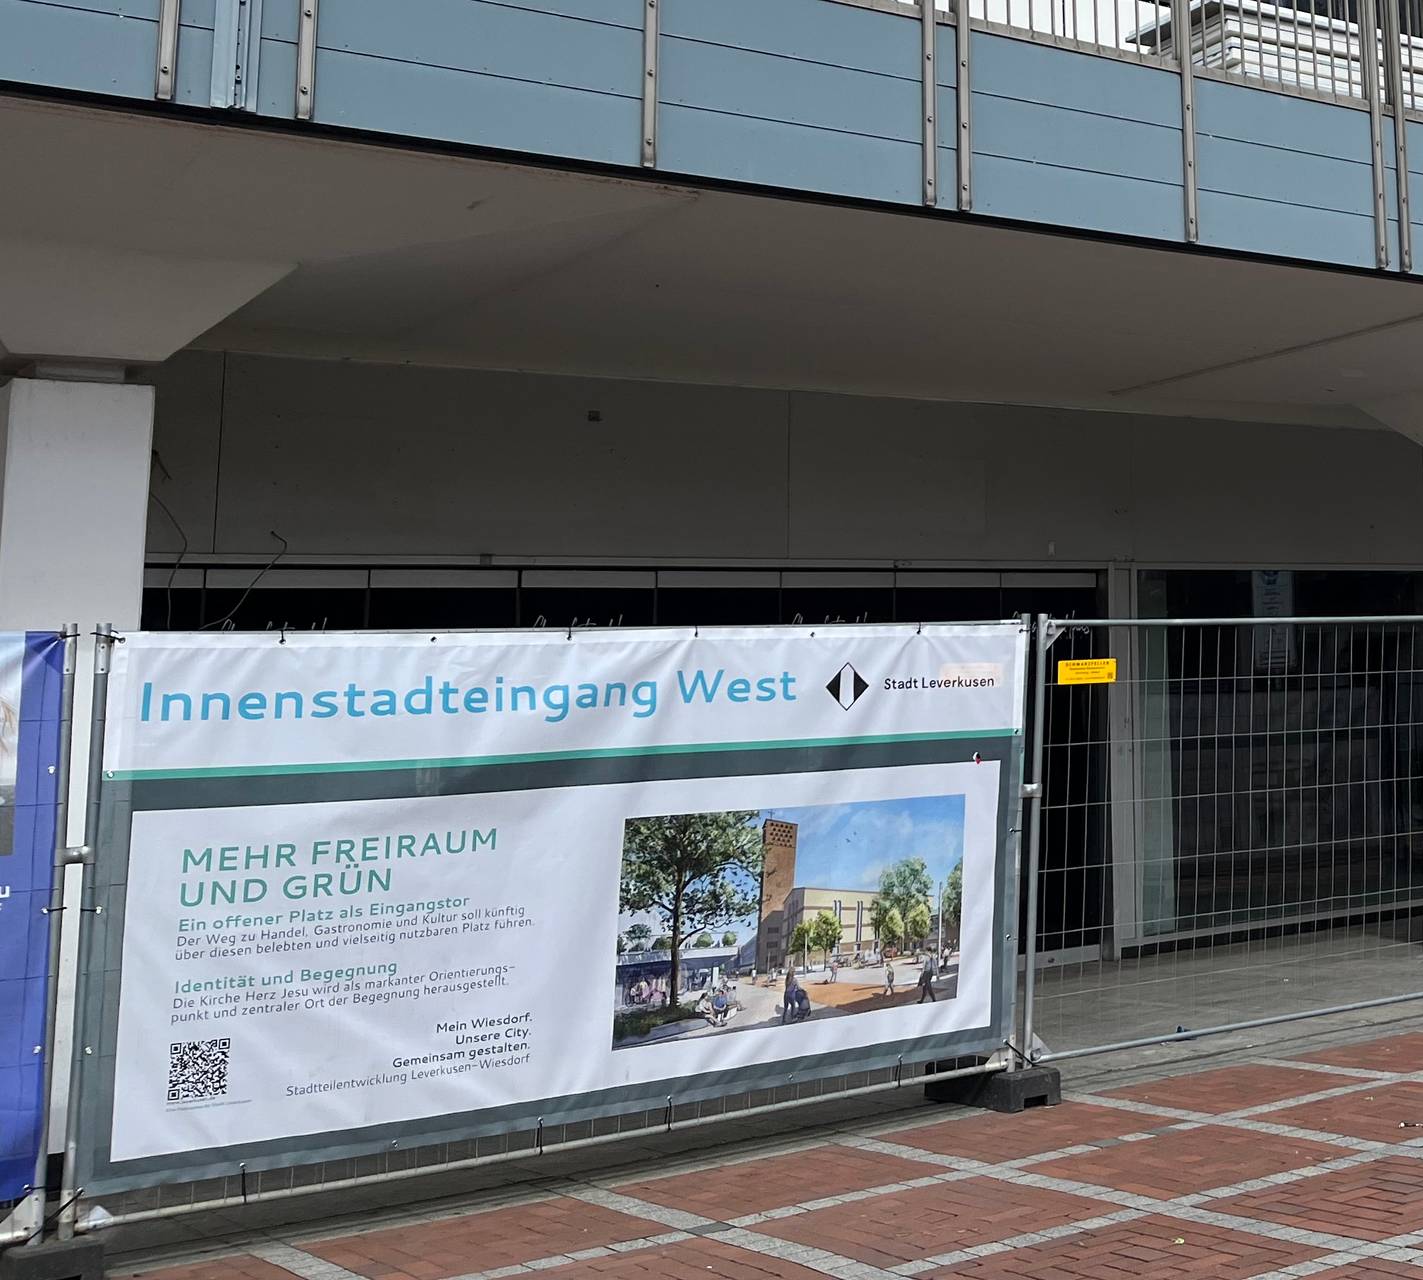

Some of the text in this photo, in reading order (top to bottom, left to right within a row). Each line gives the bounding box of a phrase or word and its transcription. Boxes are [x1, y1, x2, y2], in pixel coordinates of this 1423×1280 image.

[140, 669, 797, 722] Innenstadteingang West
[884, 676, 995, 690] Stadt Leverkusen
[182, 828, 497, 874] MEHR FREIRAUM
[180, 863, 392, 907] UND GRÜN
[177, 935, 202, 947] Der
[206, 933, 236, 946] Weg
[241, 932, 256, 942] zu
[314, 919, 392, 936] Gastronomie
[396, 915, 418, 928] und
[422, 911, 458, 924] Kultur
[461, 909, 481, 920] soll
[178, 897, 470, 932] Ein offener Platz als Eingangstor
[175, 949, 203, 961] über
[209, 945, 251, 958] diesen
[256, 941, 311, 955] belebten
[316, 936, 339, 949] und
[342, 931, 396, 946] vielseitig
[399, 925, 458, 940] nutzbaren
[462, 921, 490, 933] Platz
[173, 997, 195, 1009] Die
[200, 993, 241, 1007] Kirche
[245, 990, 276, 1003] Herz
[281, 988, 309, 1000] Jesu
[312, 982, 340, 996] wird
[344, 979, 361, 992] als
[365, 974, 426, 990] markanter
[175, 962, 397, 994] Identität und Begegnung
[171, 975, 509, 1026] punkt und zentraler Ort der Begegnung herausgestellt.
[436, 1012, 533, 1034] Mein Wiesdorf.
[455, 1026, 532, 1045] Unsere City.
[392, 1041, 531, 1069] Gemeinsam gestalten.
[286, 1053, 531, 1097] Stadtteilentwicklung Leverkusen-Wiesdorf
